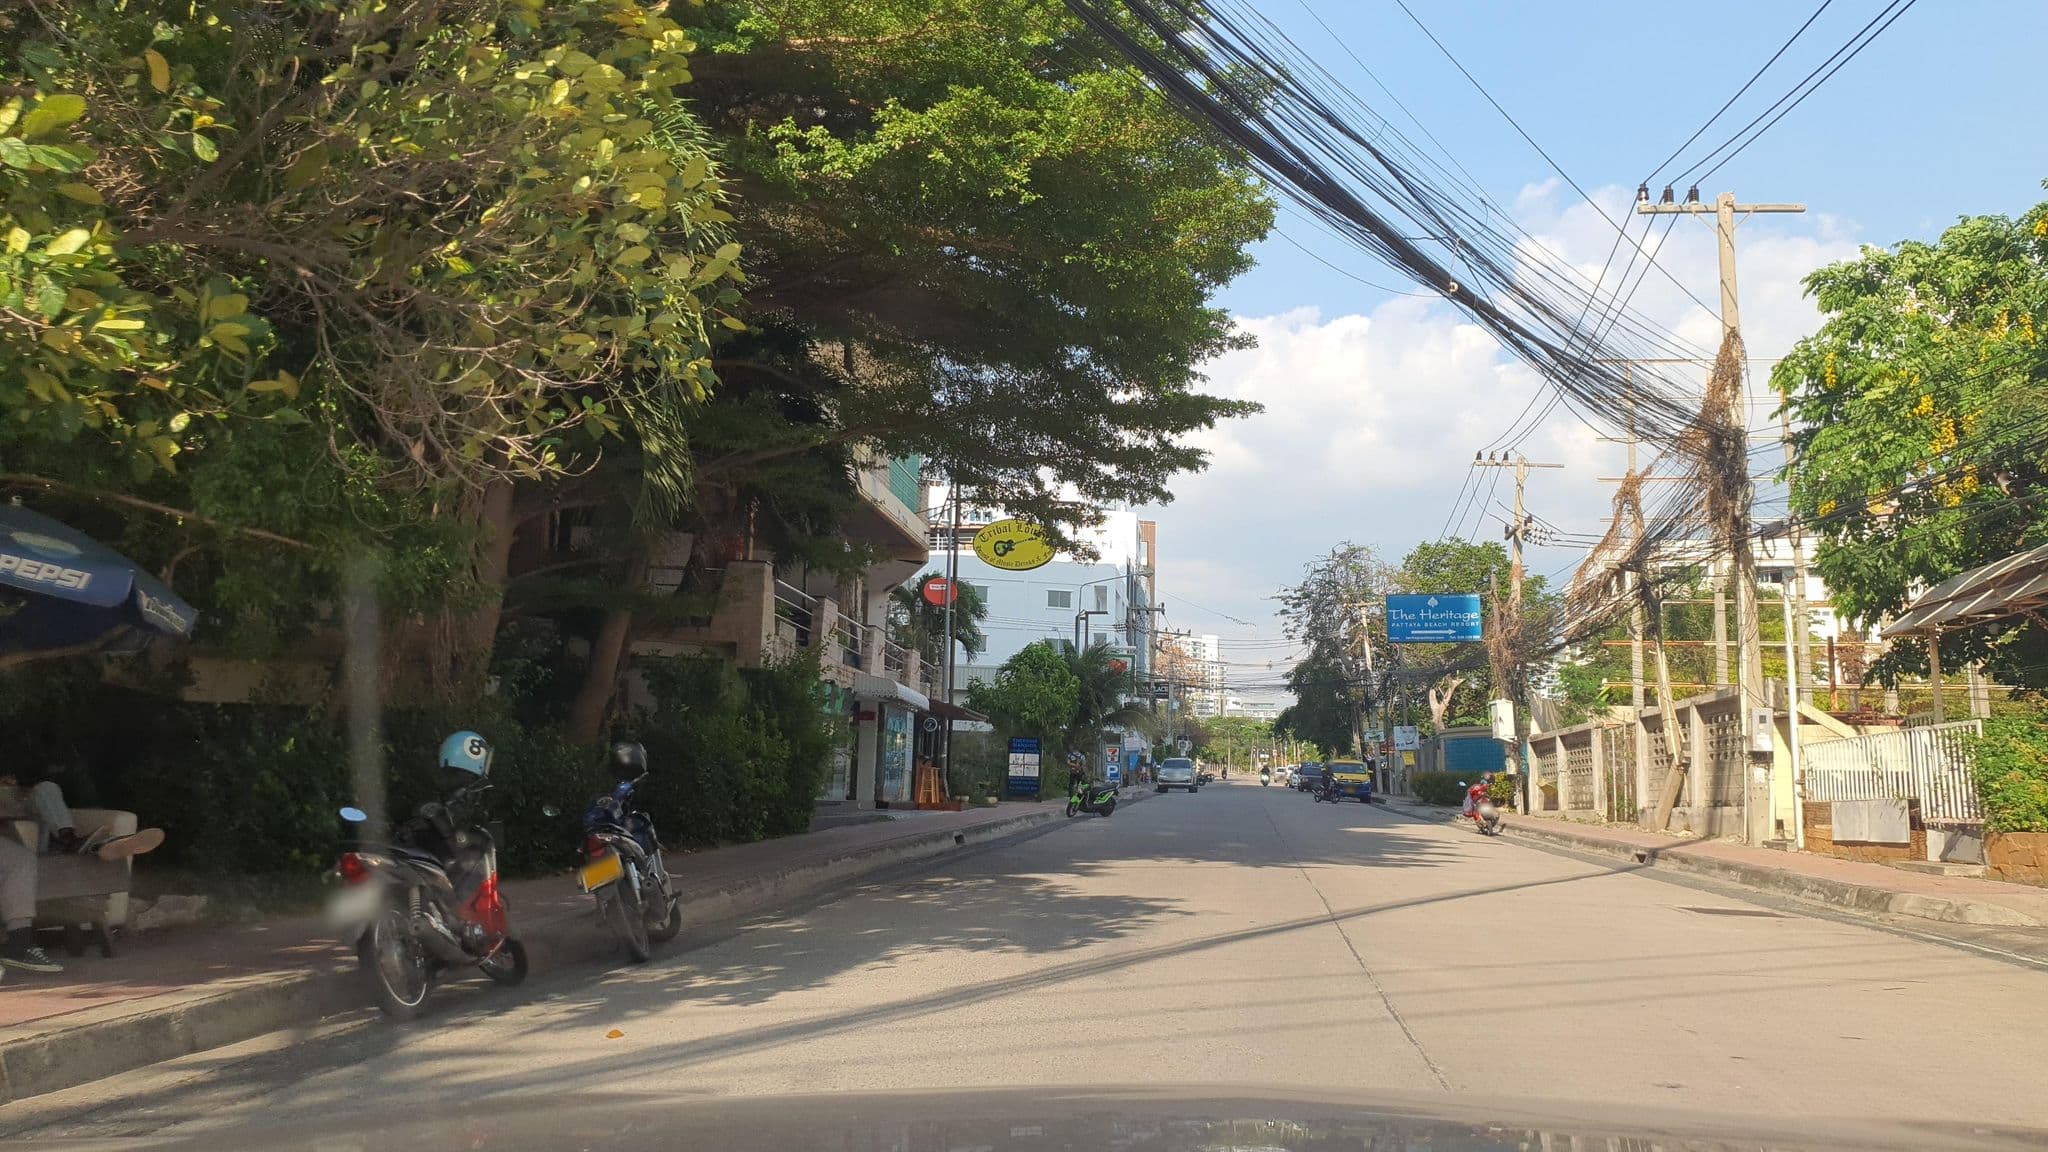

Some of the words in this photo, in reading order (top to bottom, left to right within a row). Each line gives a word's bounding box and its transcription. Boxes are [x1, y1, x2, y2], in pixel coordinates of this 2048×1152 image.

[979, 523, 1011, 543] Tribal
[0, 554, 92, 590] PEPSI
[1388, 608, 1416, 620] The
[1419, 608, 1480, 622] Heritage
[469, 739, 481, 756] 8
